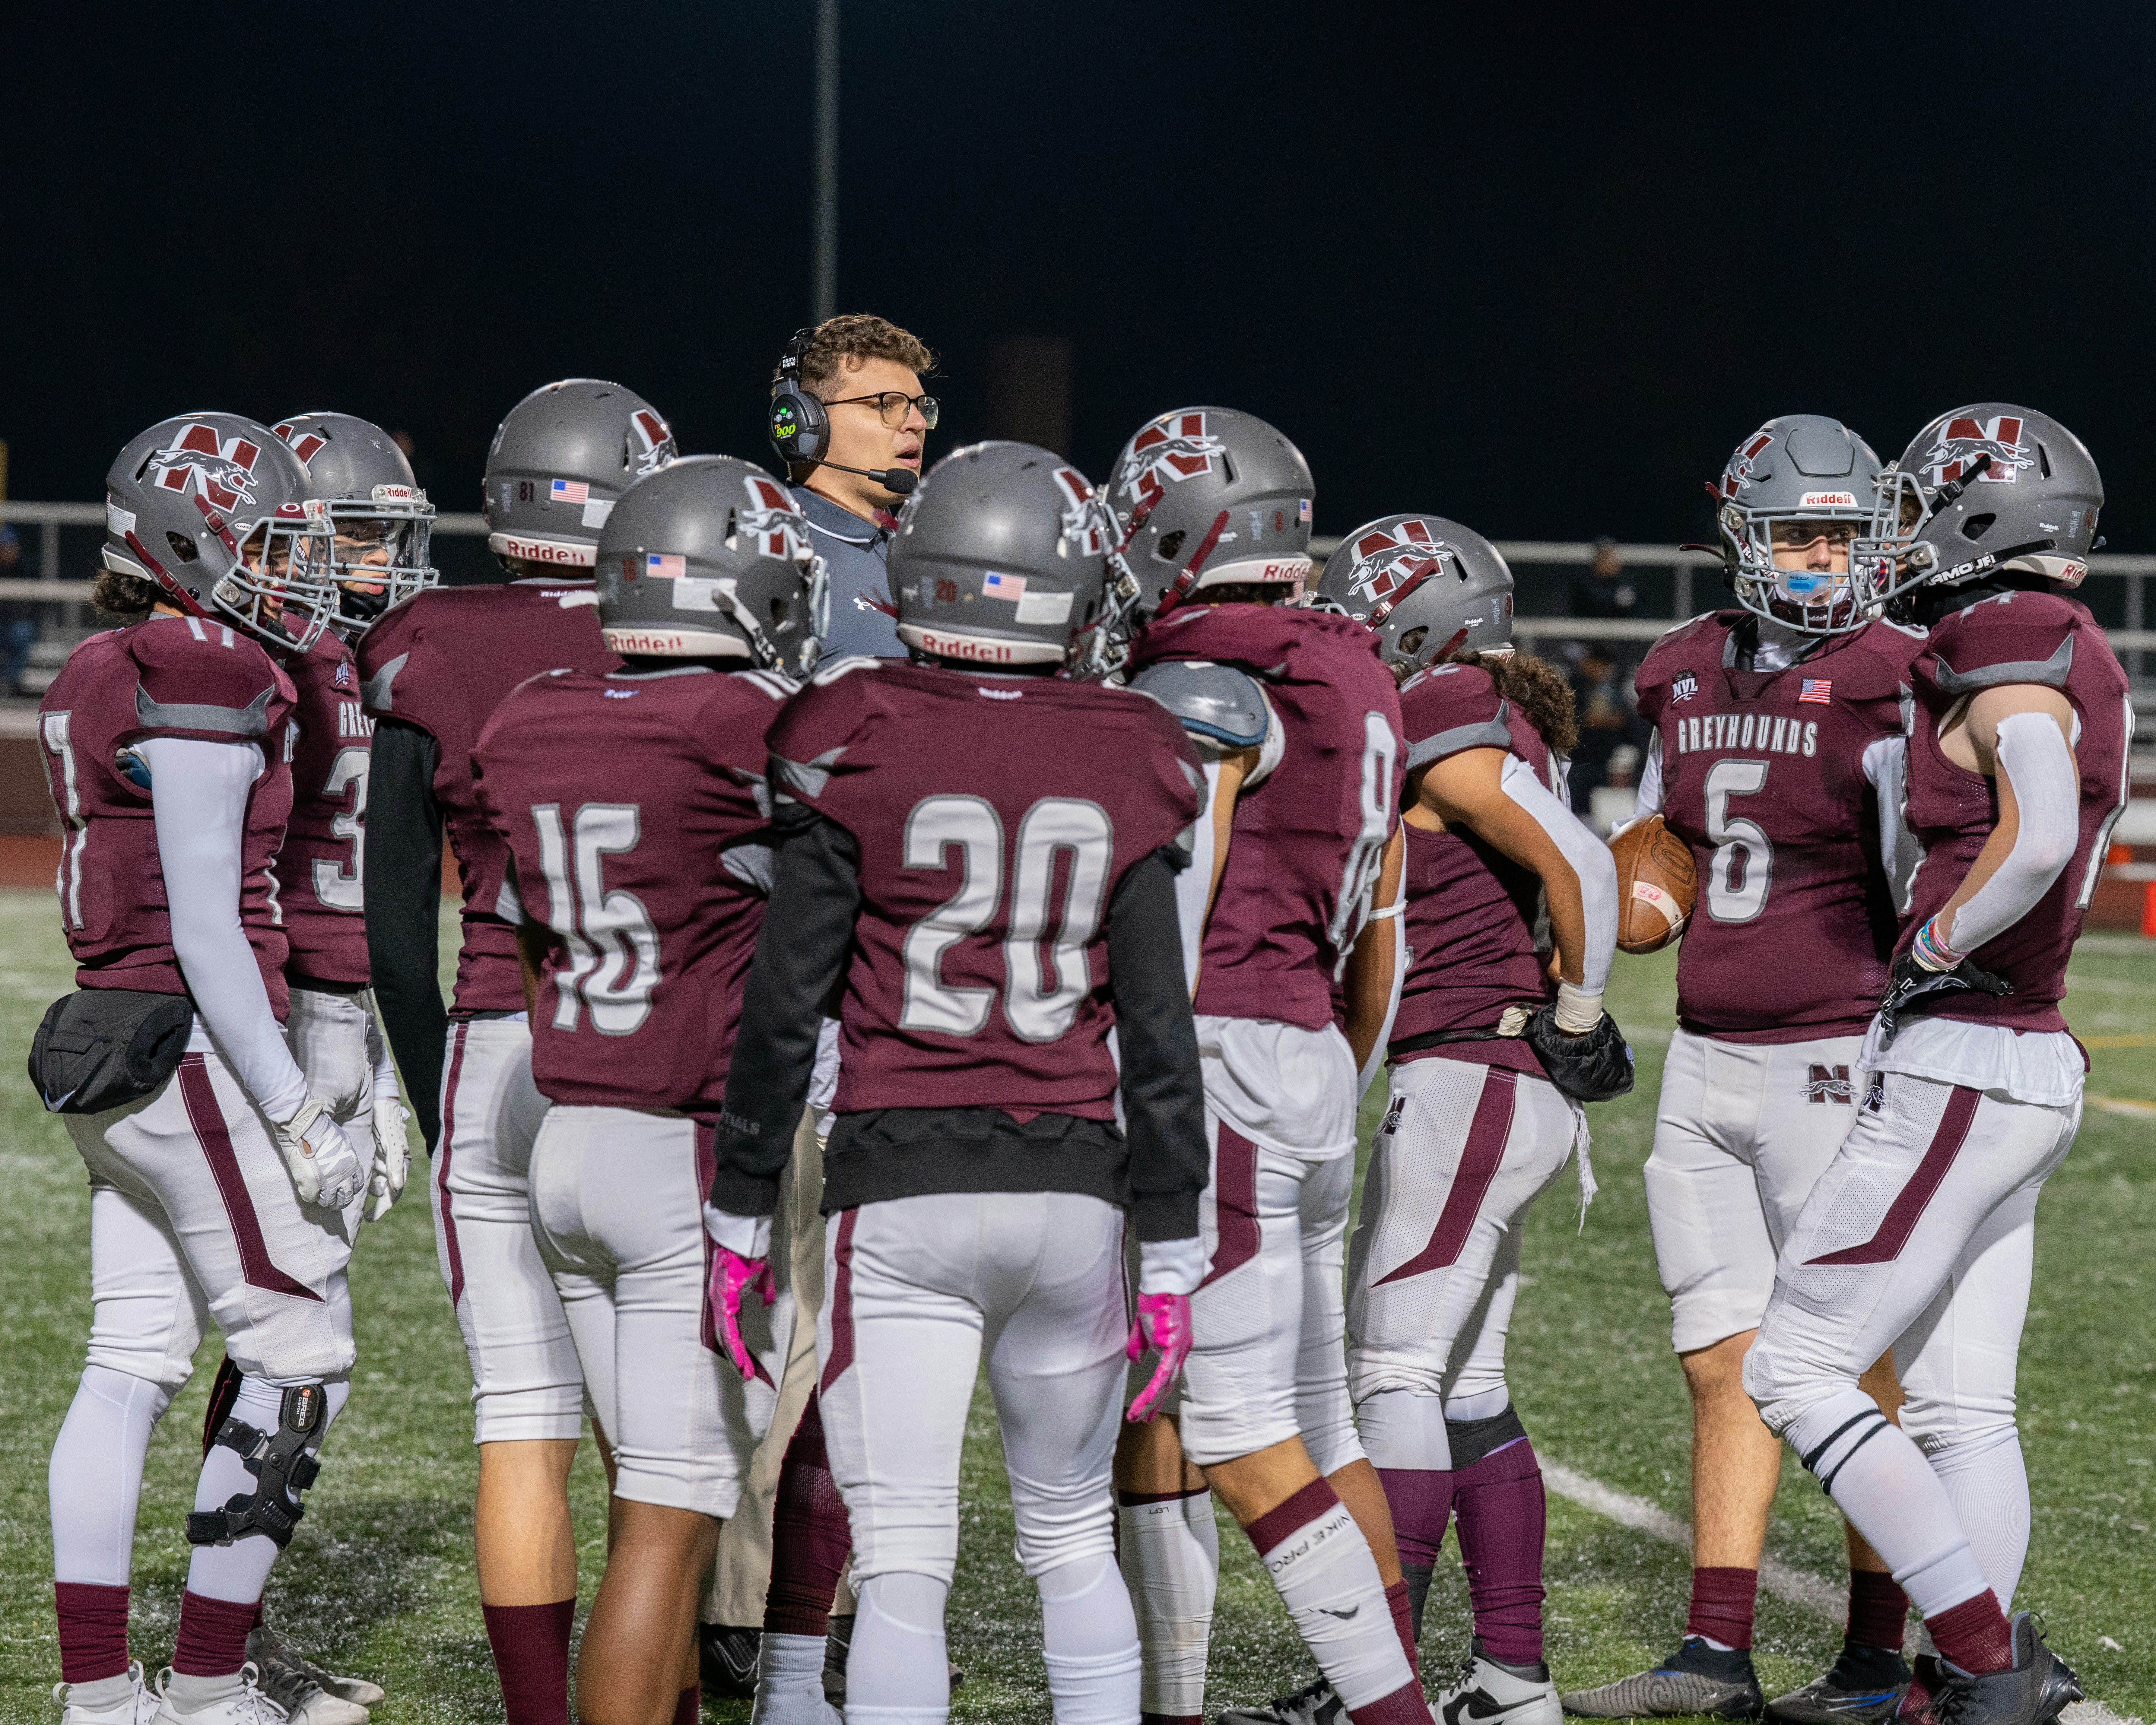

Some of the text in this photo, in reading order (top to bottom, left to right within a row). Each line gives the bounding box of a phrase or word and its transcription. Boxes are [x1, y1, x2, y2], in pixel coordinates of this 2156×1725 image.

[777, 424, 796, 438] 900
[387, 488, 411, 498] Riddell
[520, 482, 534, 502] 81
[1806, 494, 1851, 504] Riddell
[2039, 522, 2060, 531] Riddell
[507, 540, 585, 564] Riddell
[609, 634, 682, 651] Riddell
[923, 634, 1011, 662] Riddell
[1672, 677, 1699, 700] NVL
[1677, 713, 1819, 758] GREYHOUNDS
[530, 802, 663, 1037] 16
[898, 793, 1114, 1043] 20
[298, 1397, 308, 1427] BREG
[1270, 1540, 1309, 1573] PRO
